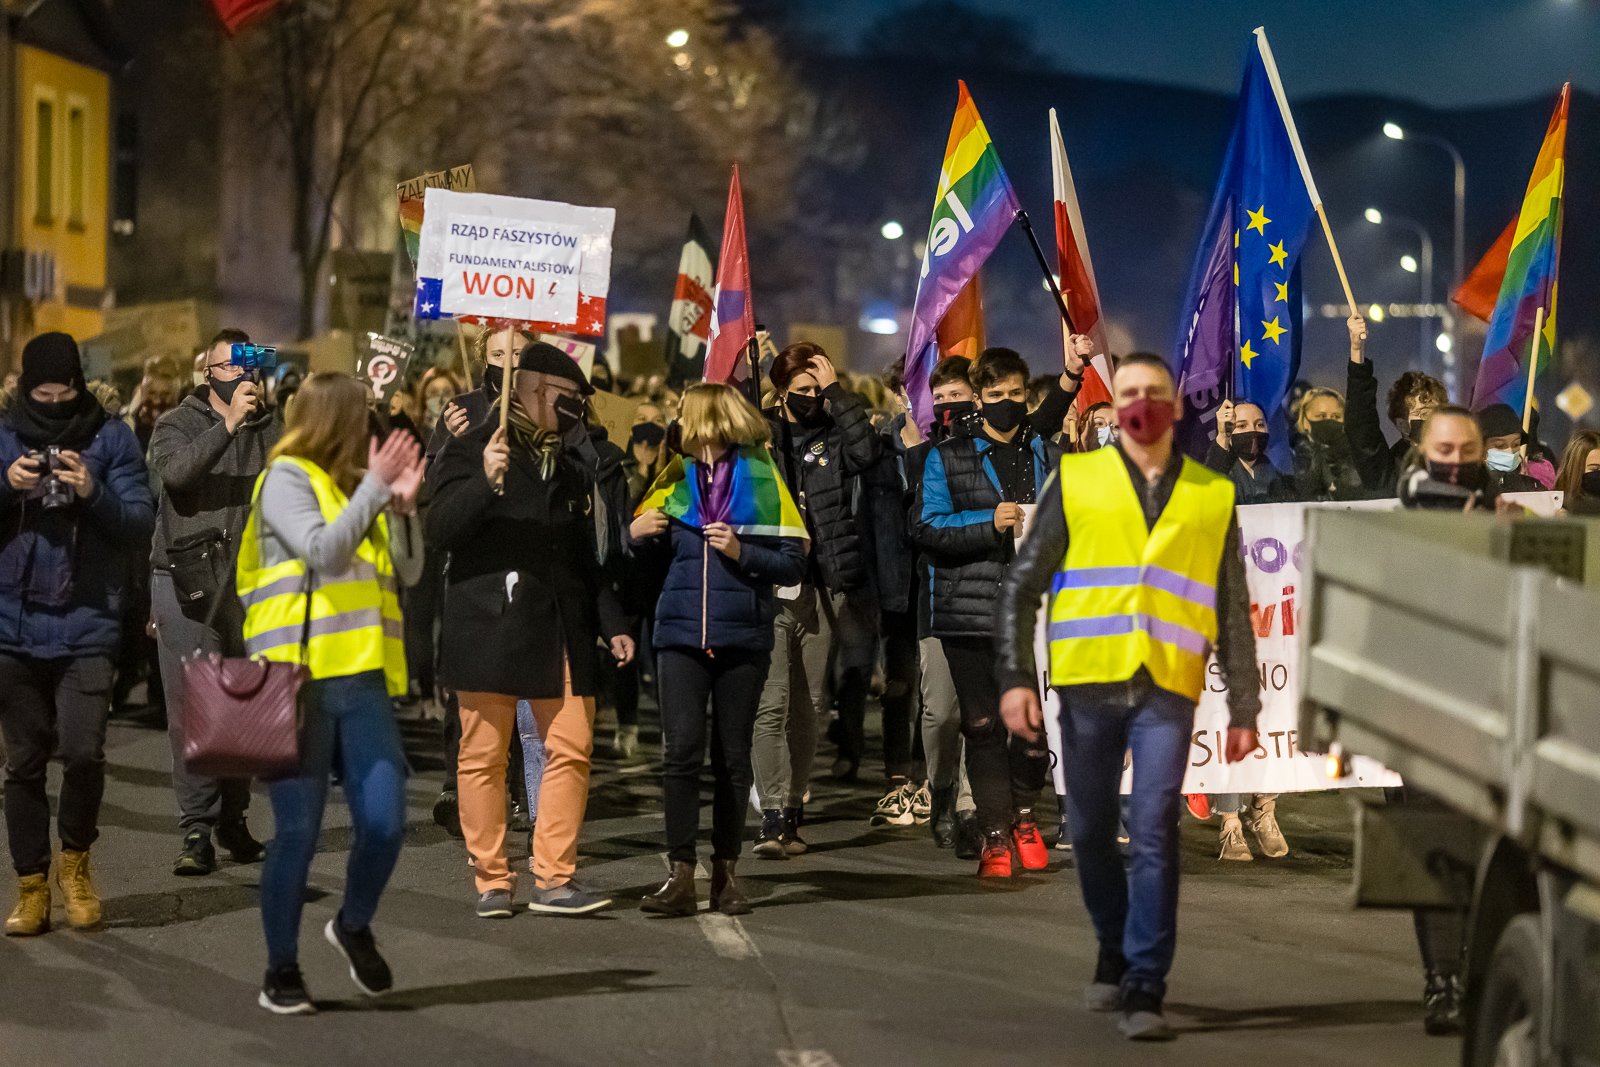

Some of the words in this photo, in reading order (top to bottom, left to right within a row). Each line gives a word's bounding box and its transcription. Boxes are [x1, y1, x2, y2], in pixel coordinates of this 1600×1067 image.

[451, 223, 489, 241] RZĄD
[493, 228, 577, 248] FASZYSTÓW
[463, 271, 535, 300] WON
